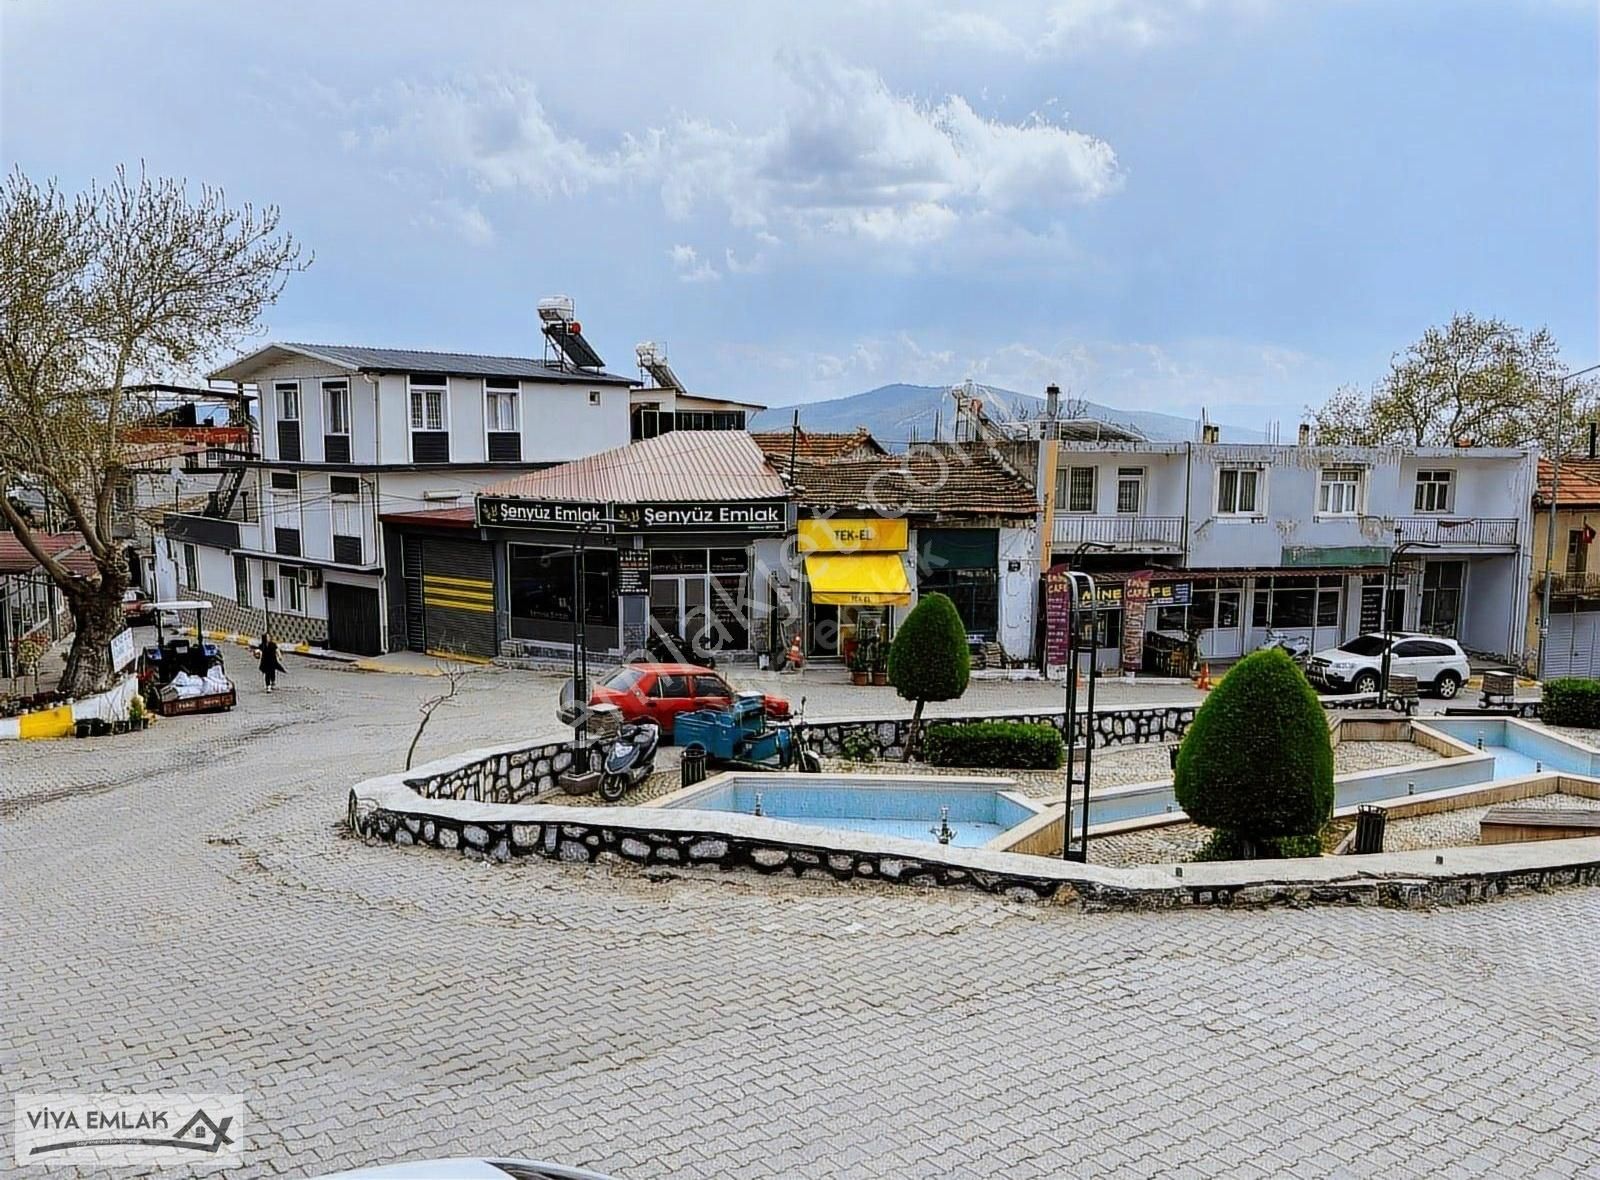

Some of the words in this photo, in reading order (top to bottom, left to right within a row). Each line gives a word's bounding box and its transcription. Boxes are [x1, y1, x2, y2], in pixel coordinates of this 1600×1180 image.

[500, 503, 550, 521] Şenyüz
[555, 506, 600, 521] Emlak
[644, 507, 713, 526] Şenyüz
[719, 507, 779, 521] Emlak
[834, 529, 872, 541] TEK-EL
[1048, 584, 1068, 594] CAFE
[1150, 586, 1172, 597] FE
